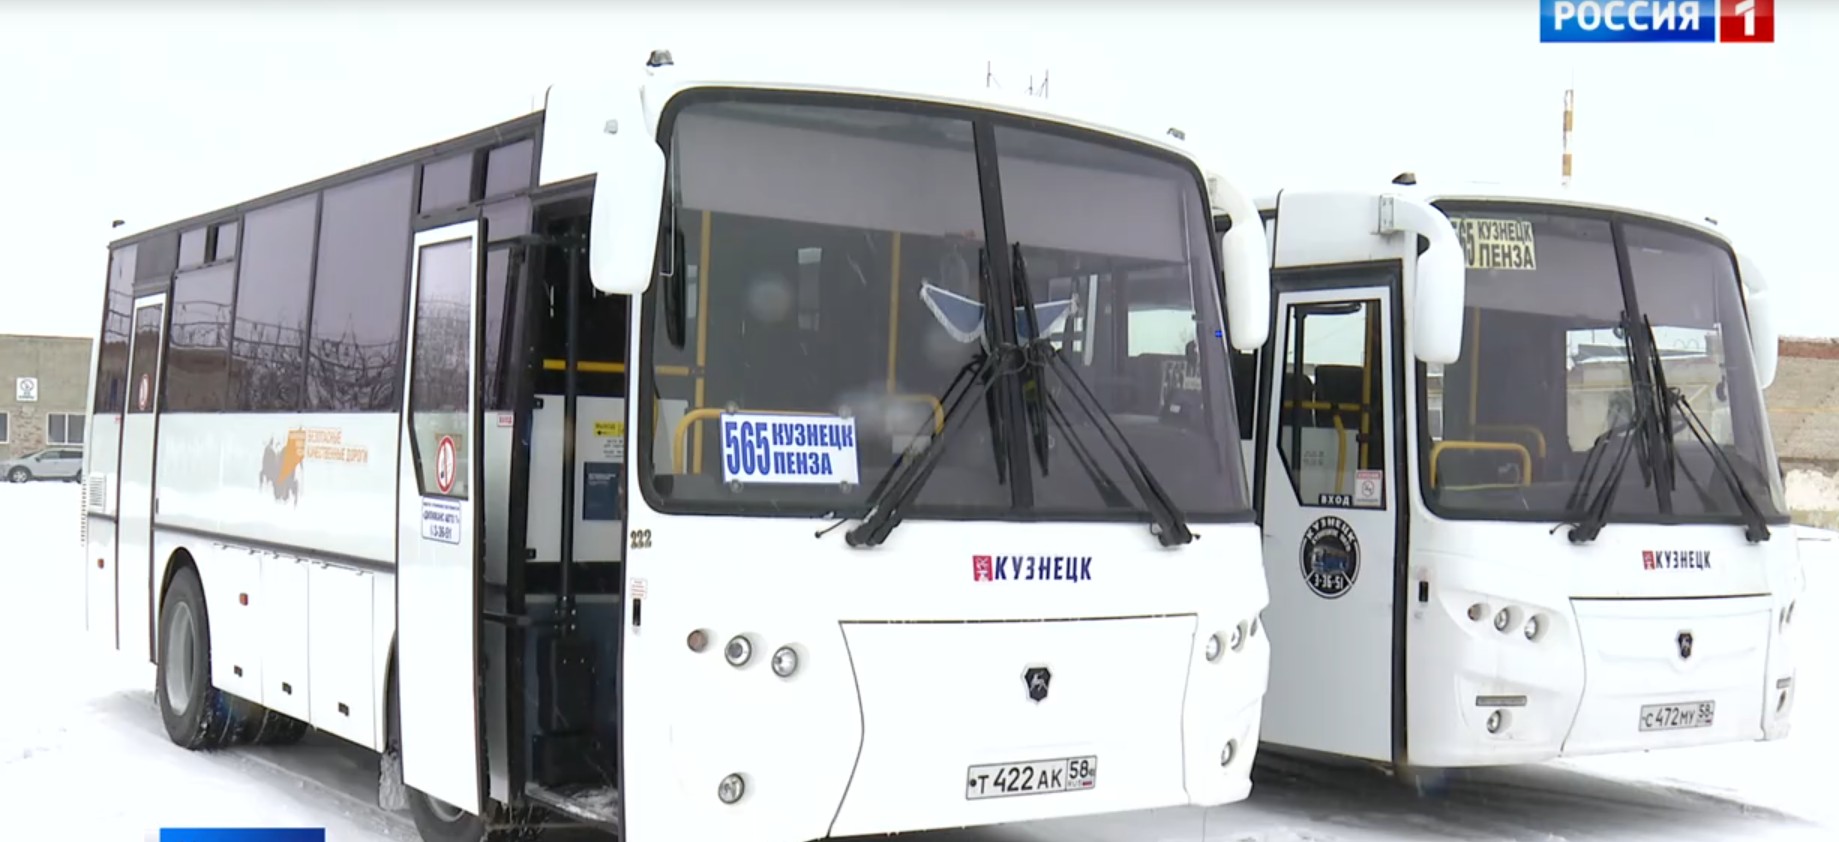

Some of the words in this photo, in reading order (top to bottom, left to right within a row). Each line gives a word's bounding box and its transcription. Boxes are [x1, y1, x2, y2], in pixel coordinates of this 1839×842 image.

[1478, 220, 1532, 244] КУЗНЕЦК
[1479, 243, 1534, 268] ПЕНЗА
[725, 421, 771, 475] 565
[772, 423, 854, 450] КУЗНЕЦК
[773, 451, 833, 475] ПЕНЗА
[1320, 495, 1351, 506] ВХОД
[1305, 517, 1356, 542] КУЗНЕЦК
[995, 555, 1092, 583] КУЗНЕЦК
[1655, 550, 1711, 570] КУЗНЕЦК
[1314, 573, 1344, 589] 3-36-51
[1699, 703, 1711, 719] 58
[1069, 759, 1089, 779] 58
